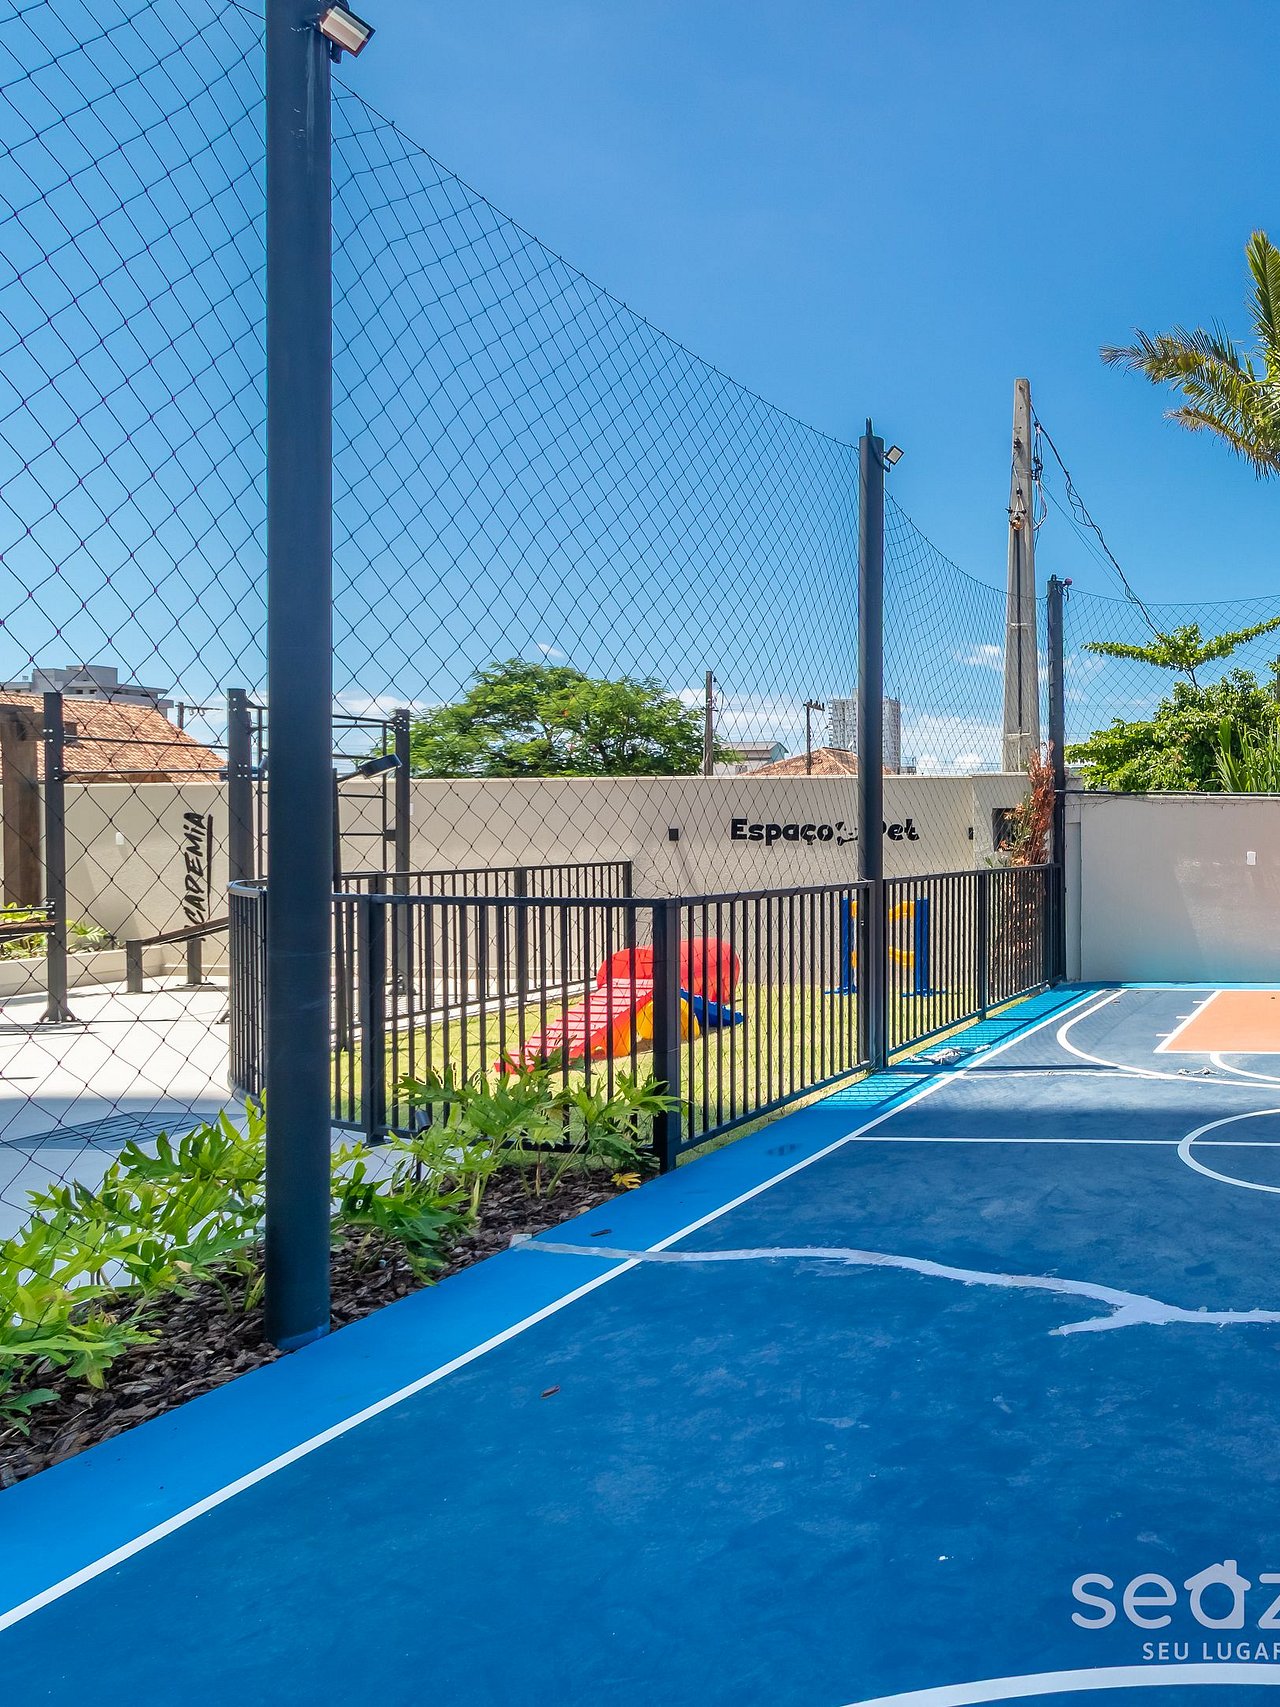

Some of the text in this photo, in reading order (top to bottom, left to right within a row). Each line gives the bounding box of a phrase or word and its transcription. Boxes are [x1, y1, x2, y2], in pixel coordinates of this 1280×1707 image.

[731, 818, 920, 847] Espaço et
[183, 812, 207, 943] CADEMiA
